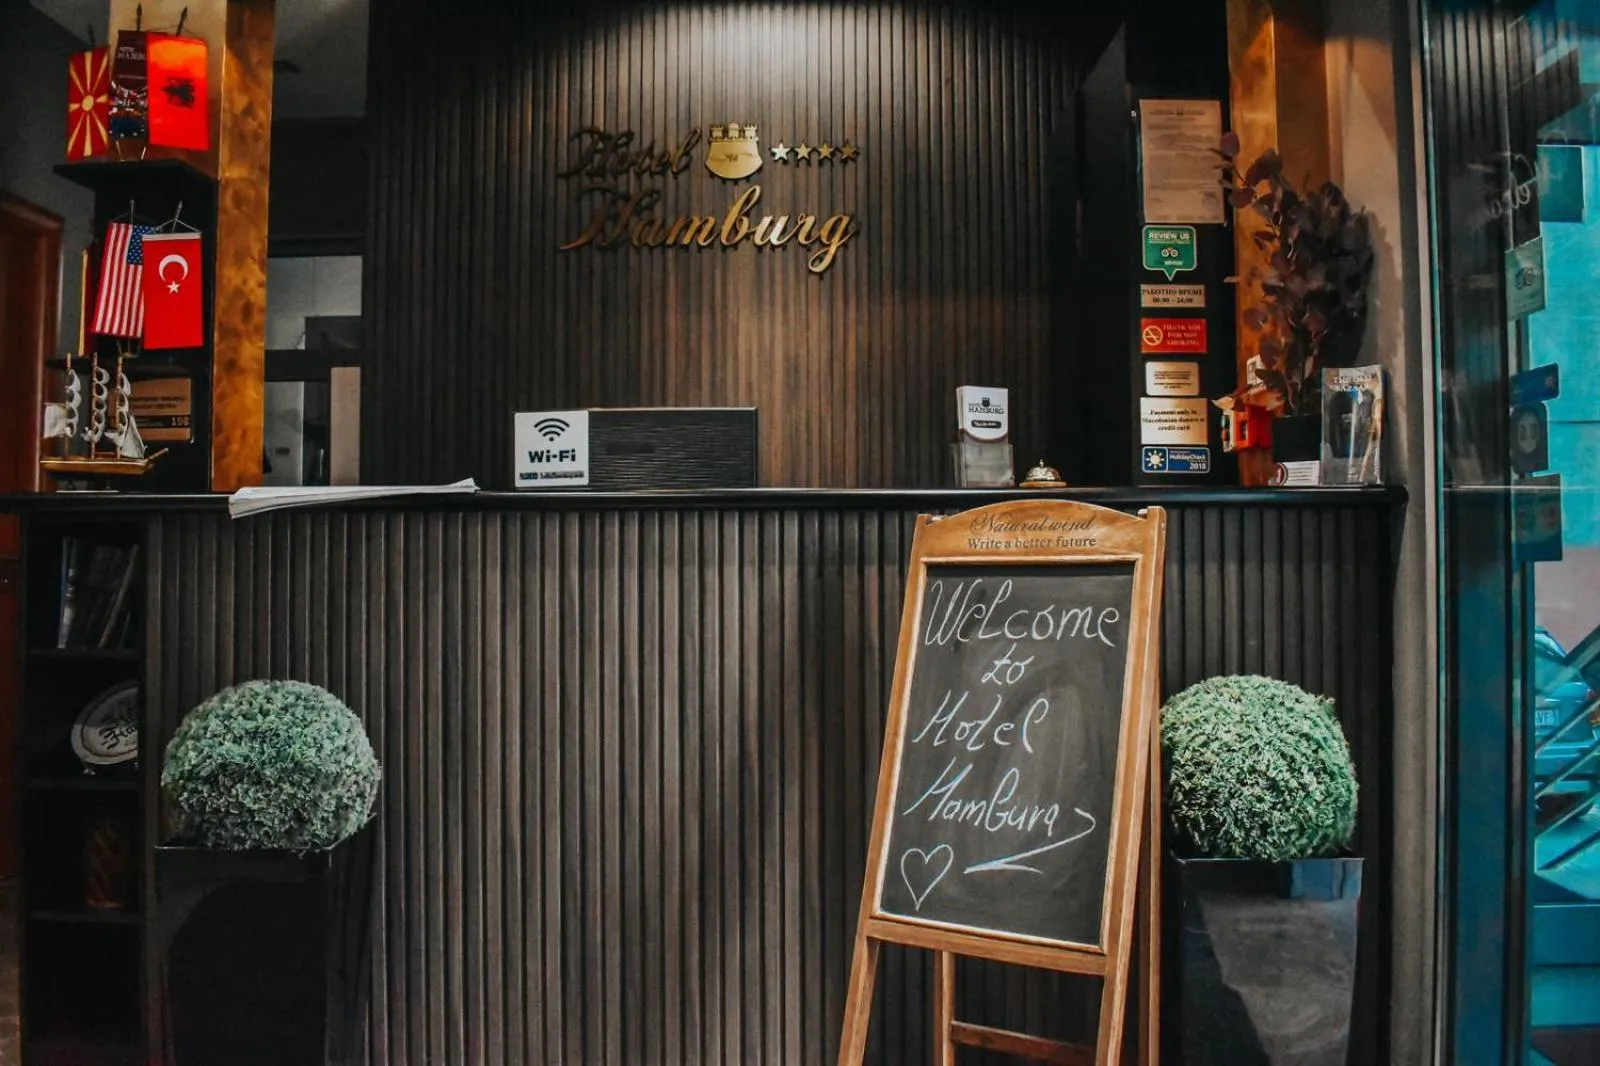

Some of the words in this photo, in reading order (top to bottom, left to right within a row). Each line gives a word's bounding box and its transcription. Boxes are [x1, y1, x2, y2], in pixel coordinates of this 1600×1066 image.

[557, 127, 702, 178] Hotel
[560, 184, 853, 273] Hamburg
[1148, 231, 1177, 239] REVIEW
[1179, 231, 1190, 239] US
[528, 448, 576, 463] Wi-Fi
[969, 511, 1050, 536] Natural
[1049, 514, 1098, 532] wind
[967, 537, 1002, 549] Write
[1004, 540, 1012, 549] a
[1014, 537, 1053, 549] better
[1055, 535, 1097, 548] future
[980, 642, 1035, 685] to
[911, 689, 1050, 754] Hotel
